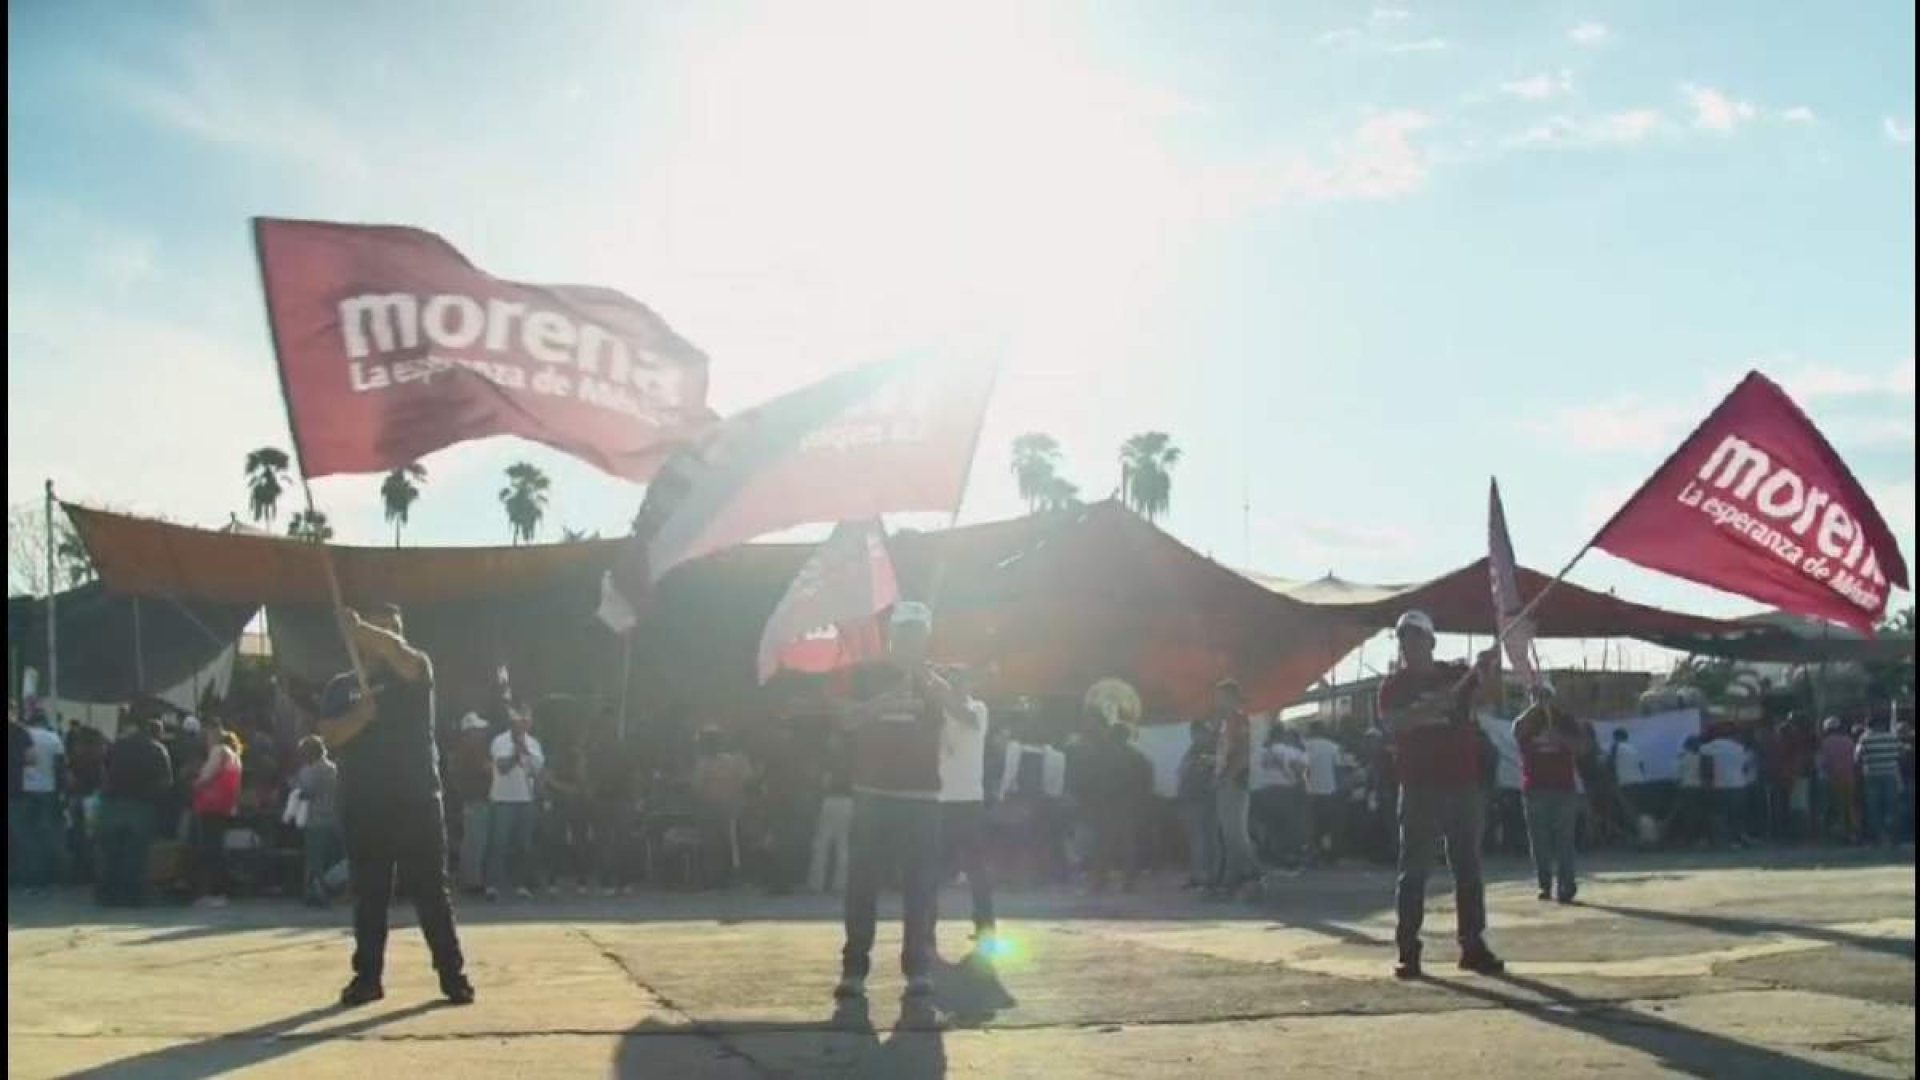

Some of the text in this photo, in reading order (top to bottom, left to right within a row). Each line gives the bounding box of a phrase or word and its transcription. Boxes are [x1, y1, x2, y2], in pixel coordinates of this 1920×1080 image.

[339, 291, 684, 406] morena
[351, 361, 390, 392] La
[532, 364, 570, 396] de
[1677, 480, 1704, 507] La
[1701, 497, 1804, 565] esperanza
[1802, 556, 1830, 580] de
[1698, 434, 1886, 586] moren
